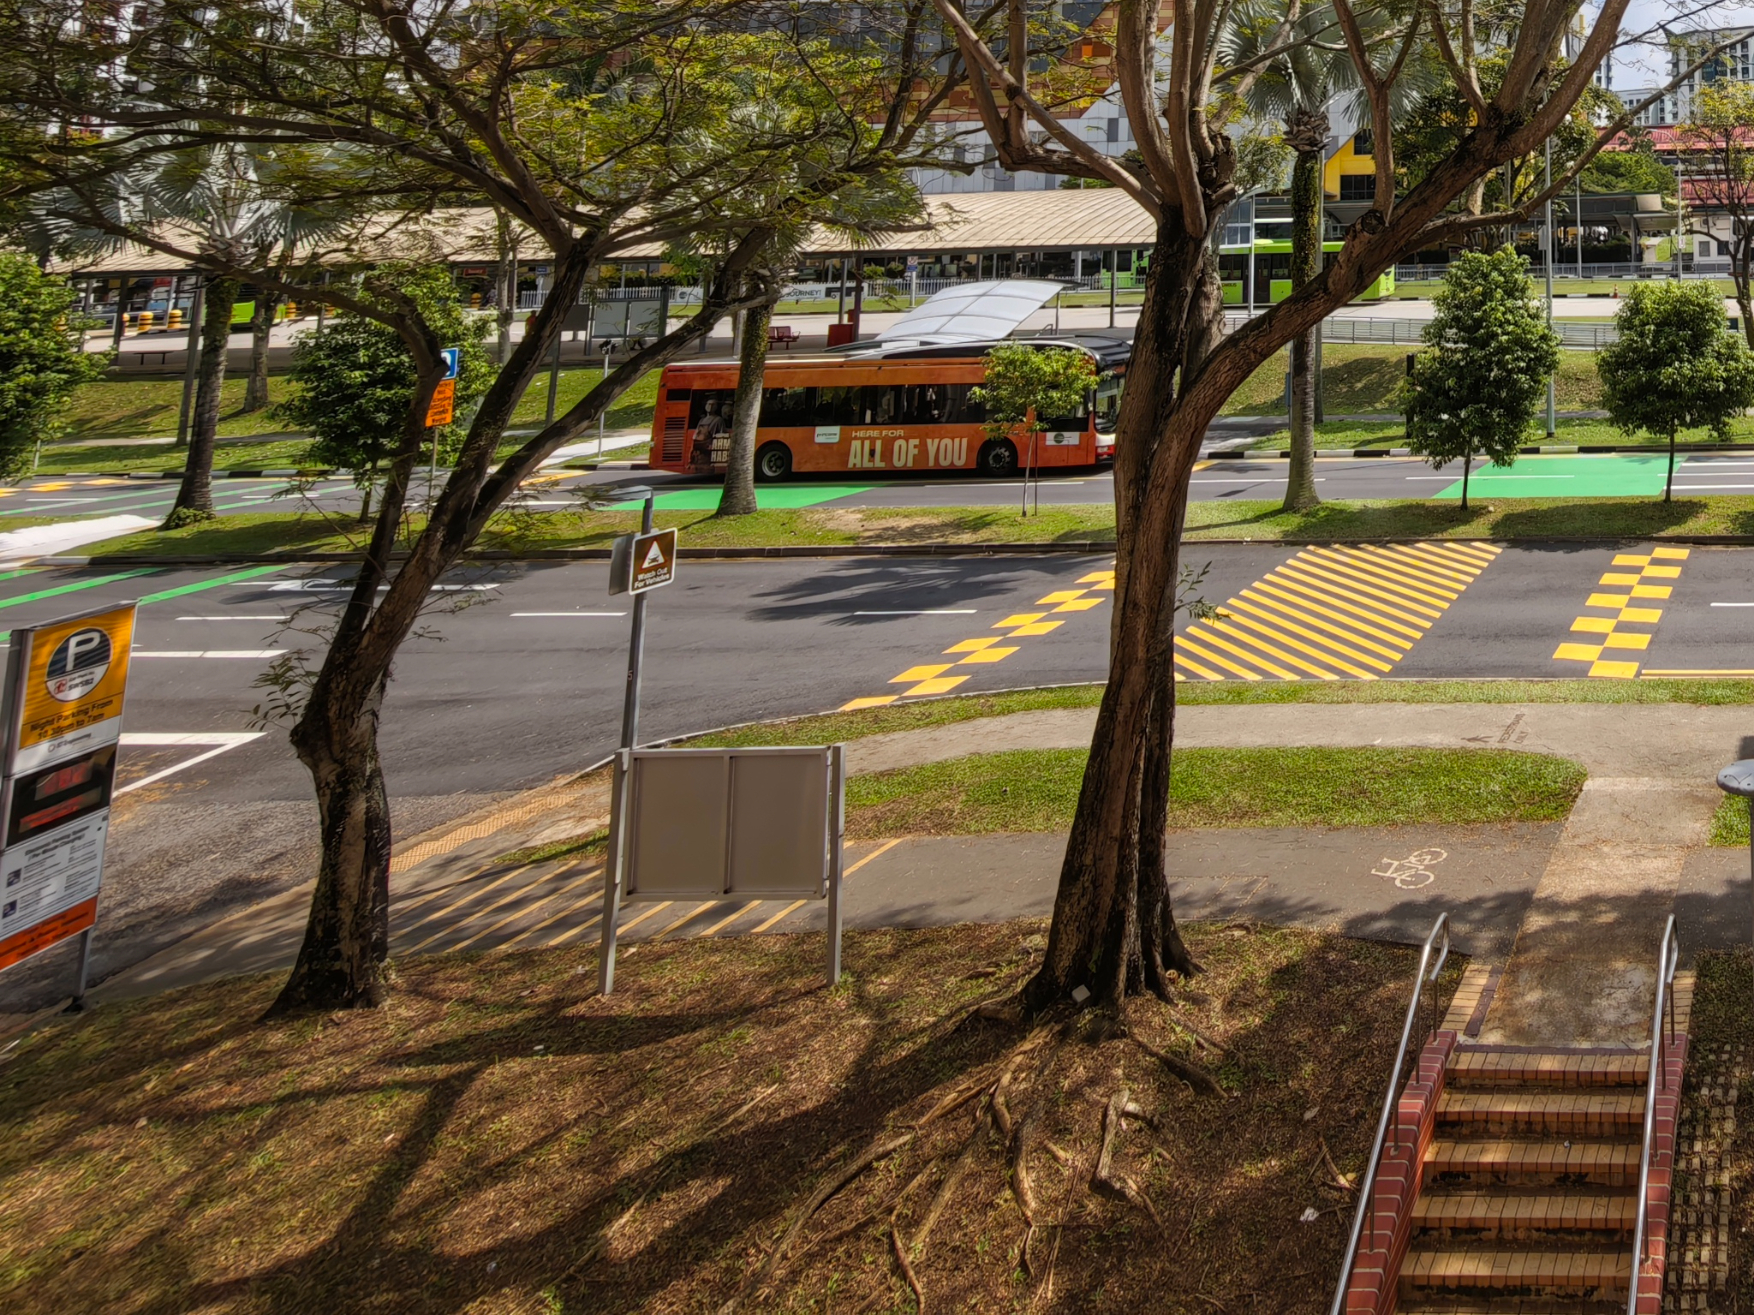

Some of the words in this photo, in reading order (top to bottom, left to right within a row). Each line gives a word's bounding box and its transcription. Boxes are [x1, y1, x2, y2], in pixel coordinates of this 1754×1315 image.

[851, 430, 880, 438] HERE
[881, 429, 904, 437] FOR
[847, 439, 886, 468] ALL
[892, 438, 920, 467] OF
[926, 437, 968, 467] YOU
[634, 581, 645, 589] For
[645, 573, 670, 586] Vehicles
[637, 570, 657, 582] Watch
[657, 567, 668, 577] Out
[65, 631, 101, 672] P
[628, 670, 633, 681] 5
[30, 717, 55, 732] Night
[56, 705, 91, 723] Parking
[92, 699, 114, 712] From
[76, 718, 85, 727] to
